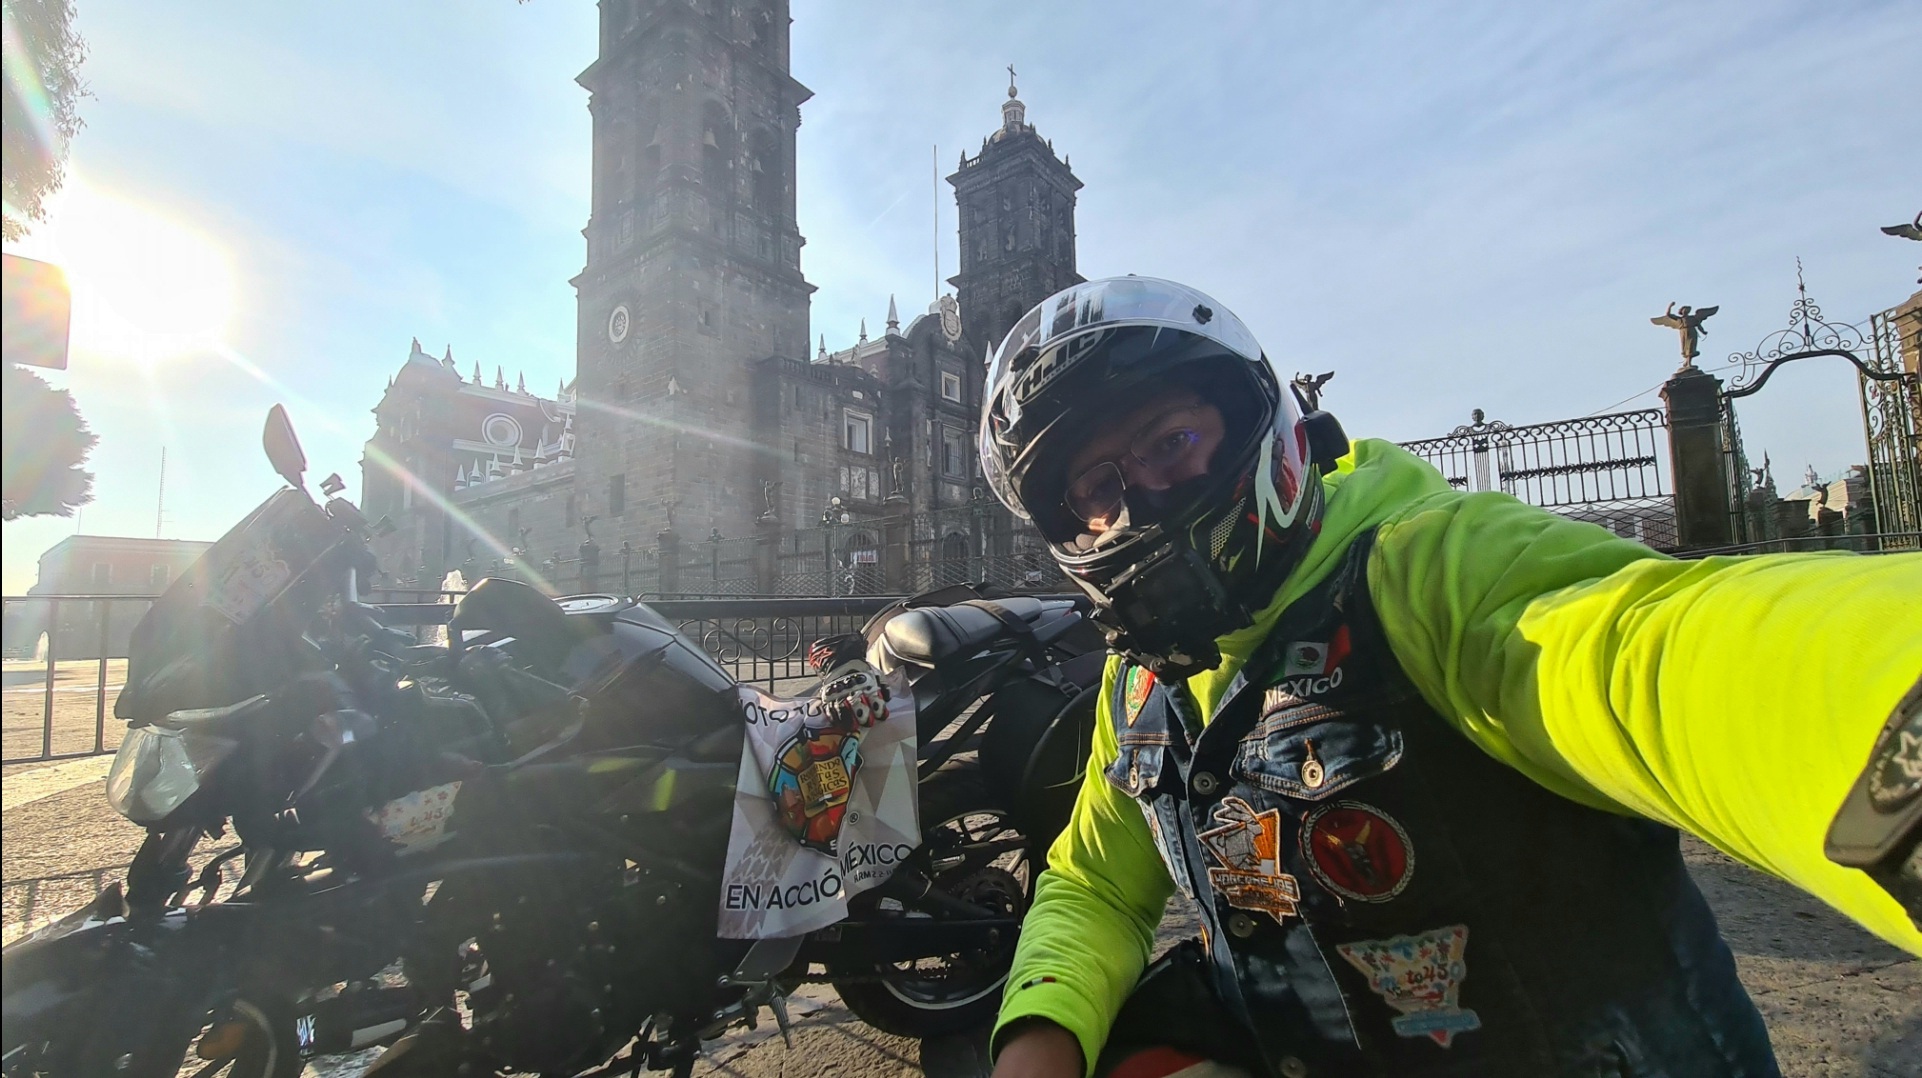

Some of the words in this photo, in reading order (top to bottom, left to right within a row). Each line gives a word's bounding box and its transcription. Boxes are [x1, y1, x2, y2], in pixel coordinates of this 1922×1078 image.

[1021, 330, 1097, 400] HJC
[740, 699, 789, 727] OTO
[1263, 666, 1343, 710] MEXICO
[726, 884, 760, 910] EN
[766, 867, 842, 910] ACCIÓ
[840, 841, 913, 880] MÉXICO
